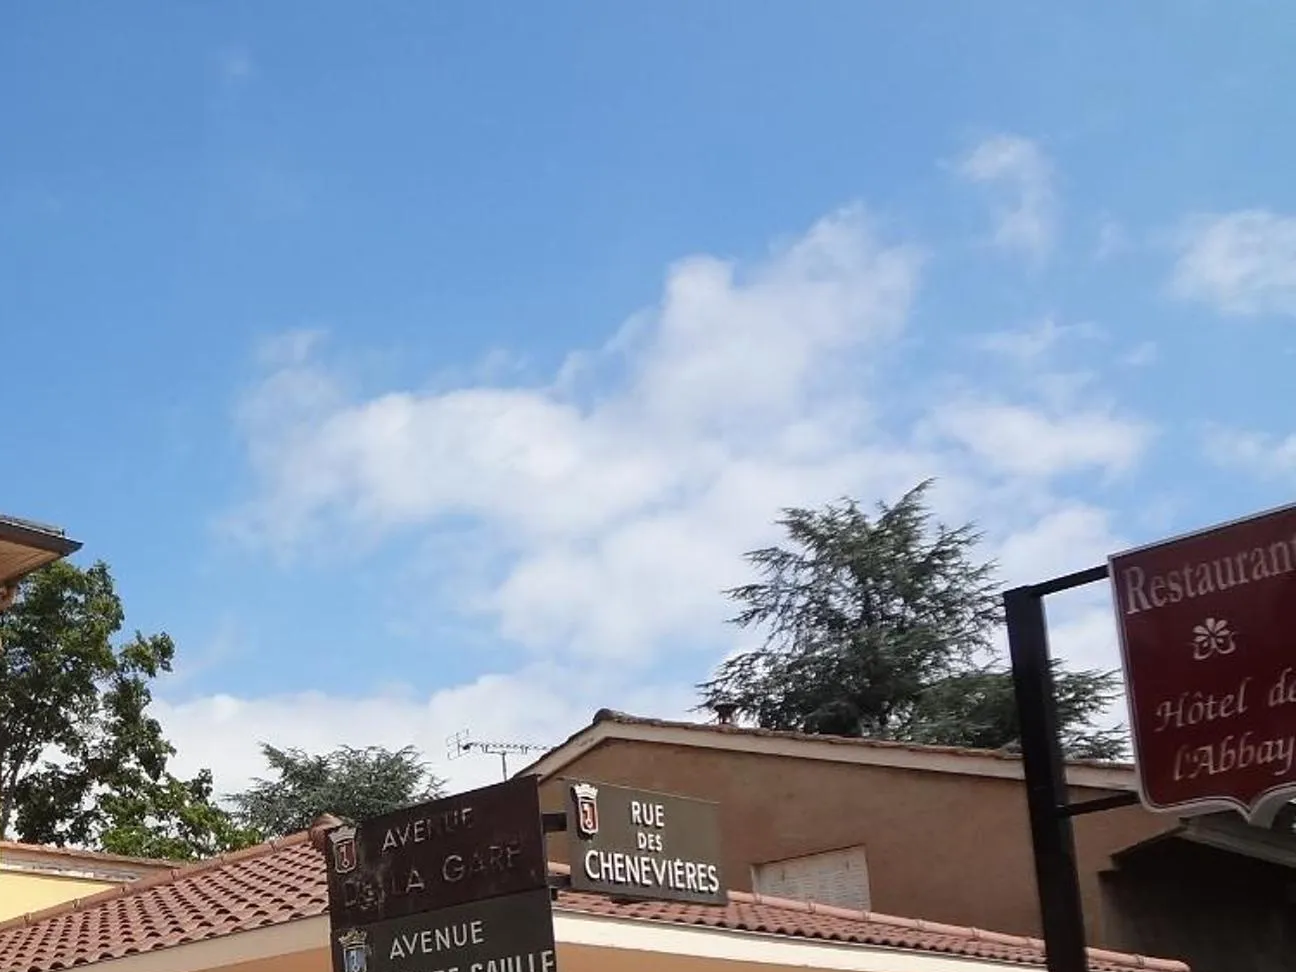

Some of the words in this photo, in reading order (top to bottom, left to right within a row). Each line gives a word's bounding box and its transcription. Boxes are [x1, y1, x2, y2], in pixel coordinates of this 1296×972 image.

[1122, 532, 1296, 614] Restauran
[1154, 676, 1252, 732] Hôtel
[1172, 731, 1296, 781] l'Abbay
[630, 800, 665, 828] RUE
[637, 831, 664, 853] DES
[584, 850, 720, 894] CHENEVIÈRES
[389, 920, 485, 961] AVENUE
